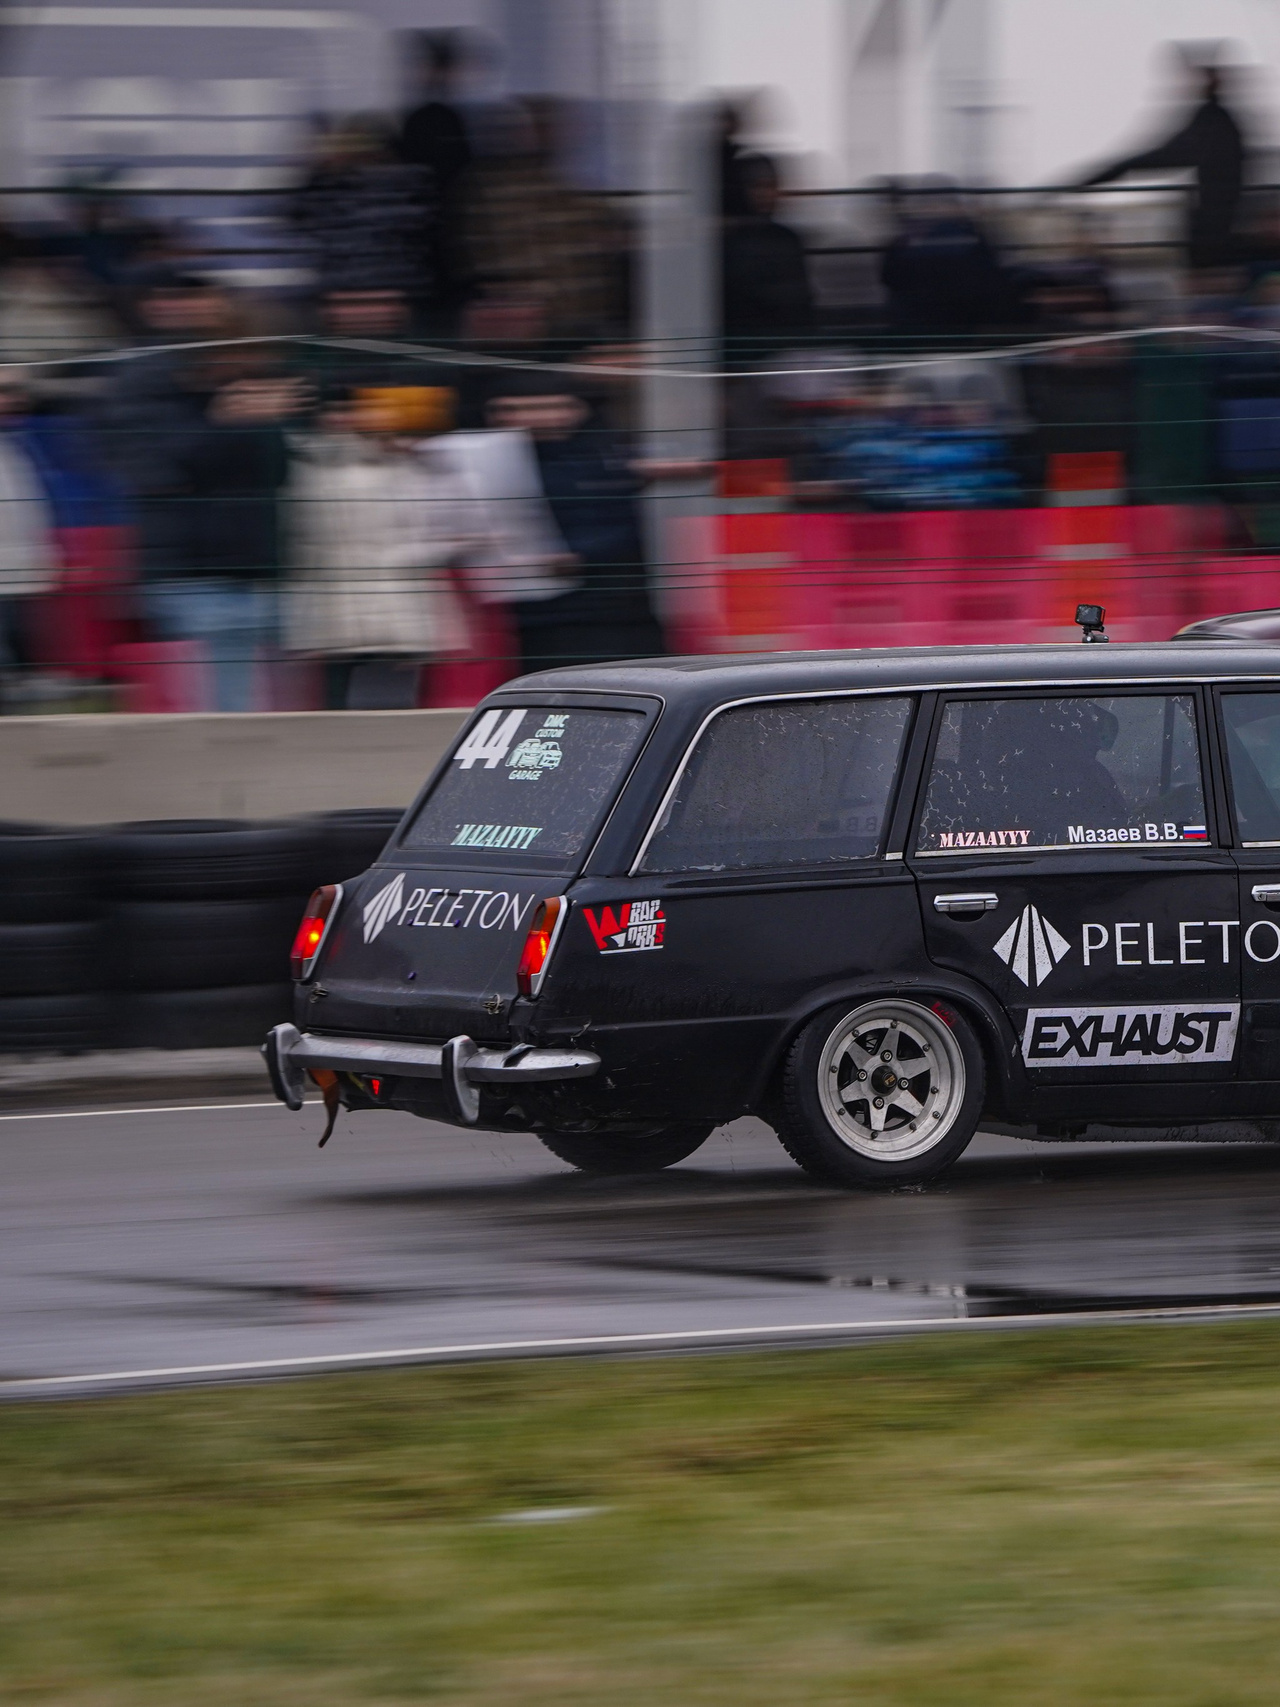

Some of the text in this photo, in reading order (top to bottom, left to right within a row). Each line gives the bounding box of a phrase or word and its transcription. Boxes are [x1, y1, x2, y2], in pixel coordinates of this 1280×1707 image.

[453, 709, 528, 769] 44
[508, 770, 543, 780] GARAGE
[450, 824, 543, 849] MAZAAYYY
[939, 830, 1031, 848] MAZAAYYY
[1067, 822, 1184, 842] Мазаев В.В.
[397, 888, 536, 931] PELETON
[1032, 1012, 1232, 1059] EXHAUST
